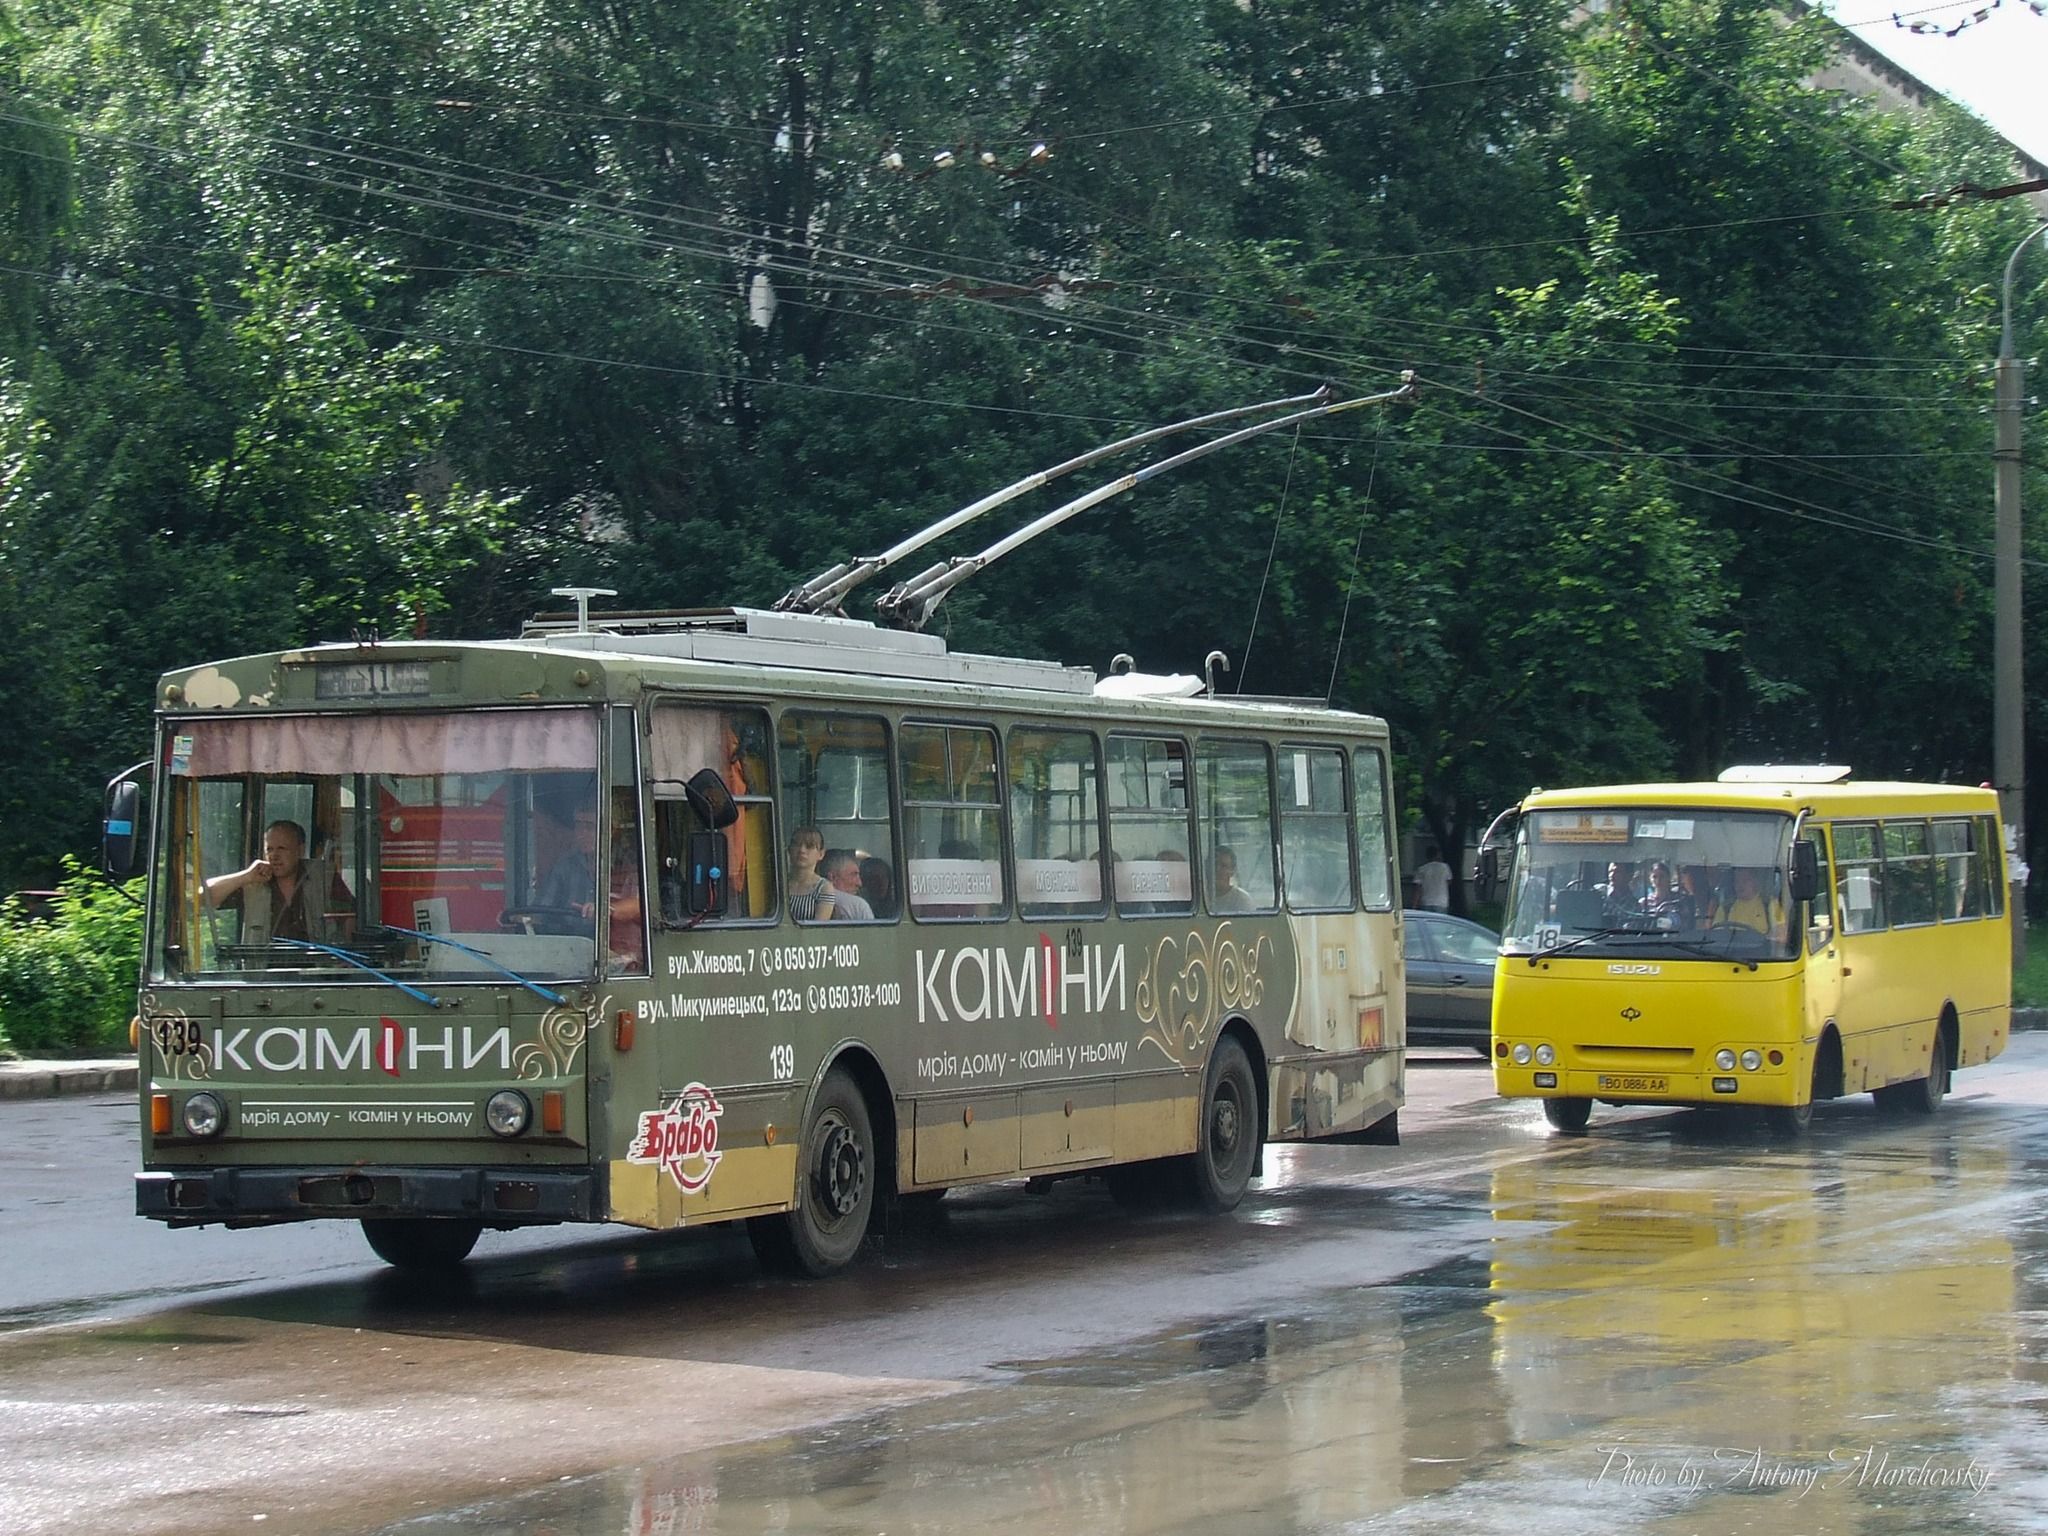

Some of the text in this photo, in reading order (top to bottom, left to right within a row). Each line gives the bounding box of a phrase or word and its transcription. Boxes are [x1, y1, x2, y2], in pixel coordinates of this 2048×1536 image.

[367, 663, 390, 692] 11
[911, 872, 992, 896] ВИГОТОВЛЕННЯ
[1035, 871, 1079, 893] МОНТАЖ
[1131, 869, 1172, 893] ГАРАНТІЯ
[1065, 927, 1083, 958] 139
[1535, 929, 1558, 950] 18
[748, 949, 756, 972] 7
[784, 945, 806, 970] 050
[808, 944, 860, 969] 377-1000
[1607, 964, 1661, 975] ISUZU
[638, 999, 669, 1024] вул.
[671, 993, 769, 1022] Микулинецька,
[828, 985, 850, 1009] 050
[851, 983, 901, 1008] 378-1000
[160, 1020, 201, 1056] 139
[770, 1044, 795, 1080] 139
[918, 1050, 957, 1083] мрія
[960, 1052, 1007, 1078] дому
[1019, 1042, 1063, 1071] камін
[1067, 1046, 1078, 1071] у
[1080, 1041, 1128, 1065] ньому
[241, 1109, 280, 1127] мрія
[283, 1110, 331, 1127] дому
[348, 1109, 399, 1123] камін
[402, 1110, 413, 1126] у
[416, 1111, 473, 1127] ньому
[641, 1107, 719, 1168] Браво
